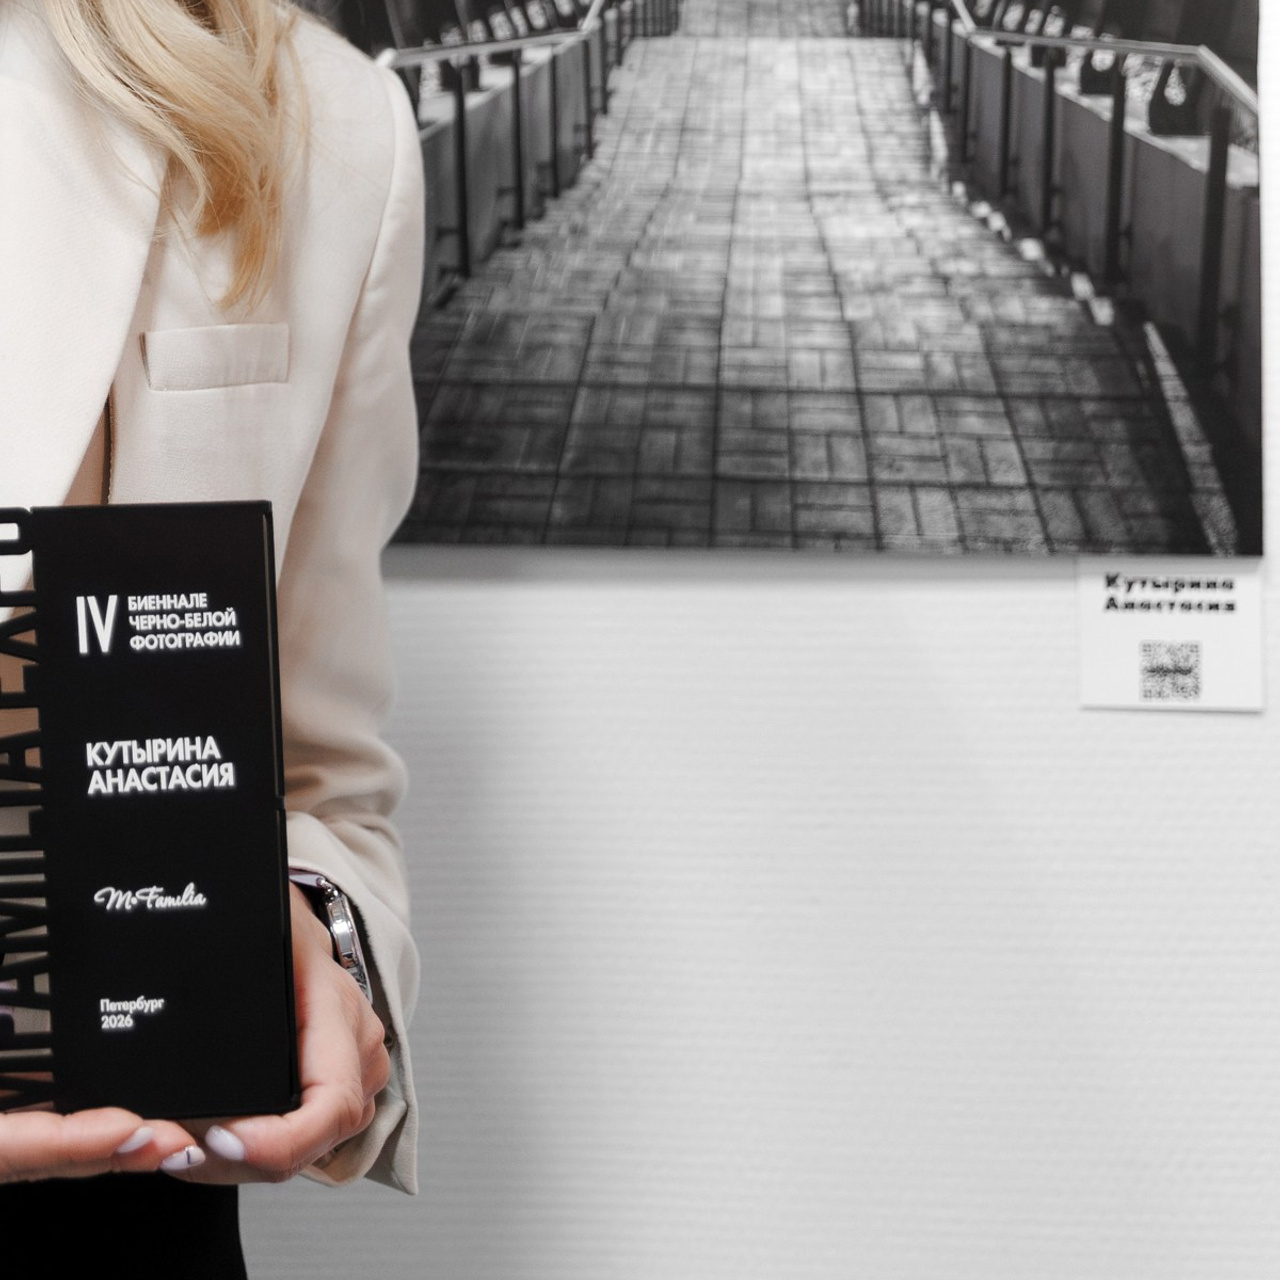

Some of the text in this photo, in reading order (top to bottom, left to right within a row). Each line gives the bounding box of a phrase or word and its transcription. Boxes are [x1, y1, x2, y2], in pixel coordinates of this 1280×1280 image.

[1105, 573, 1235, 592] Кутырина
[128, 593, 208, 611] БИЕННАЛЕ
[1104, 596, 1237, 612] Анастасия
[76, 595, 118, 654] IV
[128, 607, 237, 631] ЧЕРНО-БЕЛОЙ
[129, 630, 241, 651] ФОТОГРАФИИ
[86, 735, 222, 767] КУТЫРИНА
[87, 762, 236, 795] АНАСТАСИЯ
[100, 995, 165, 1014] Петербург
[101, 1013, 134, 1029] 2026
